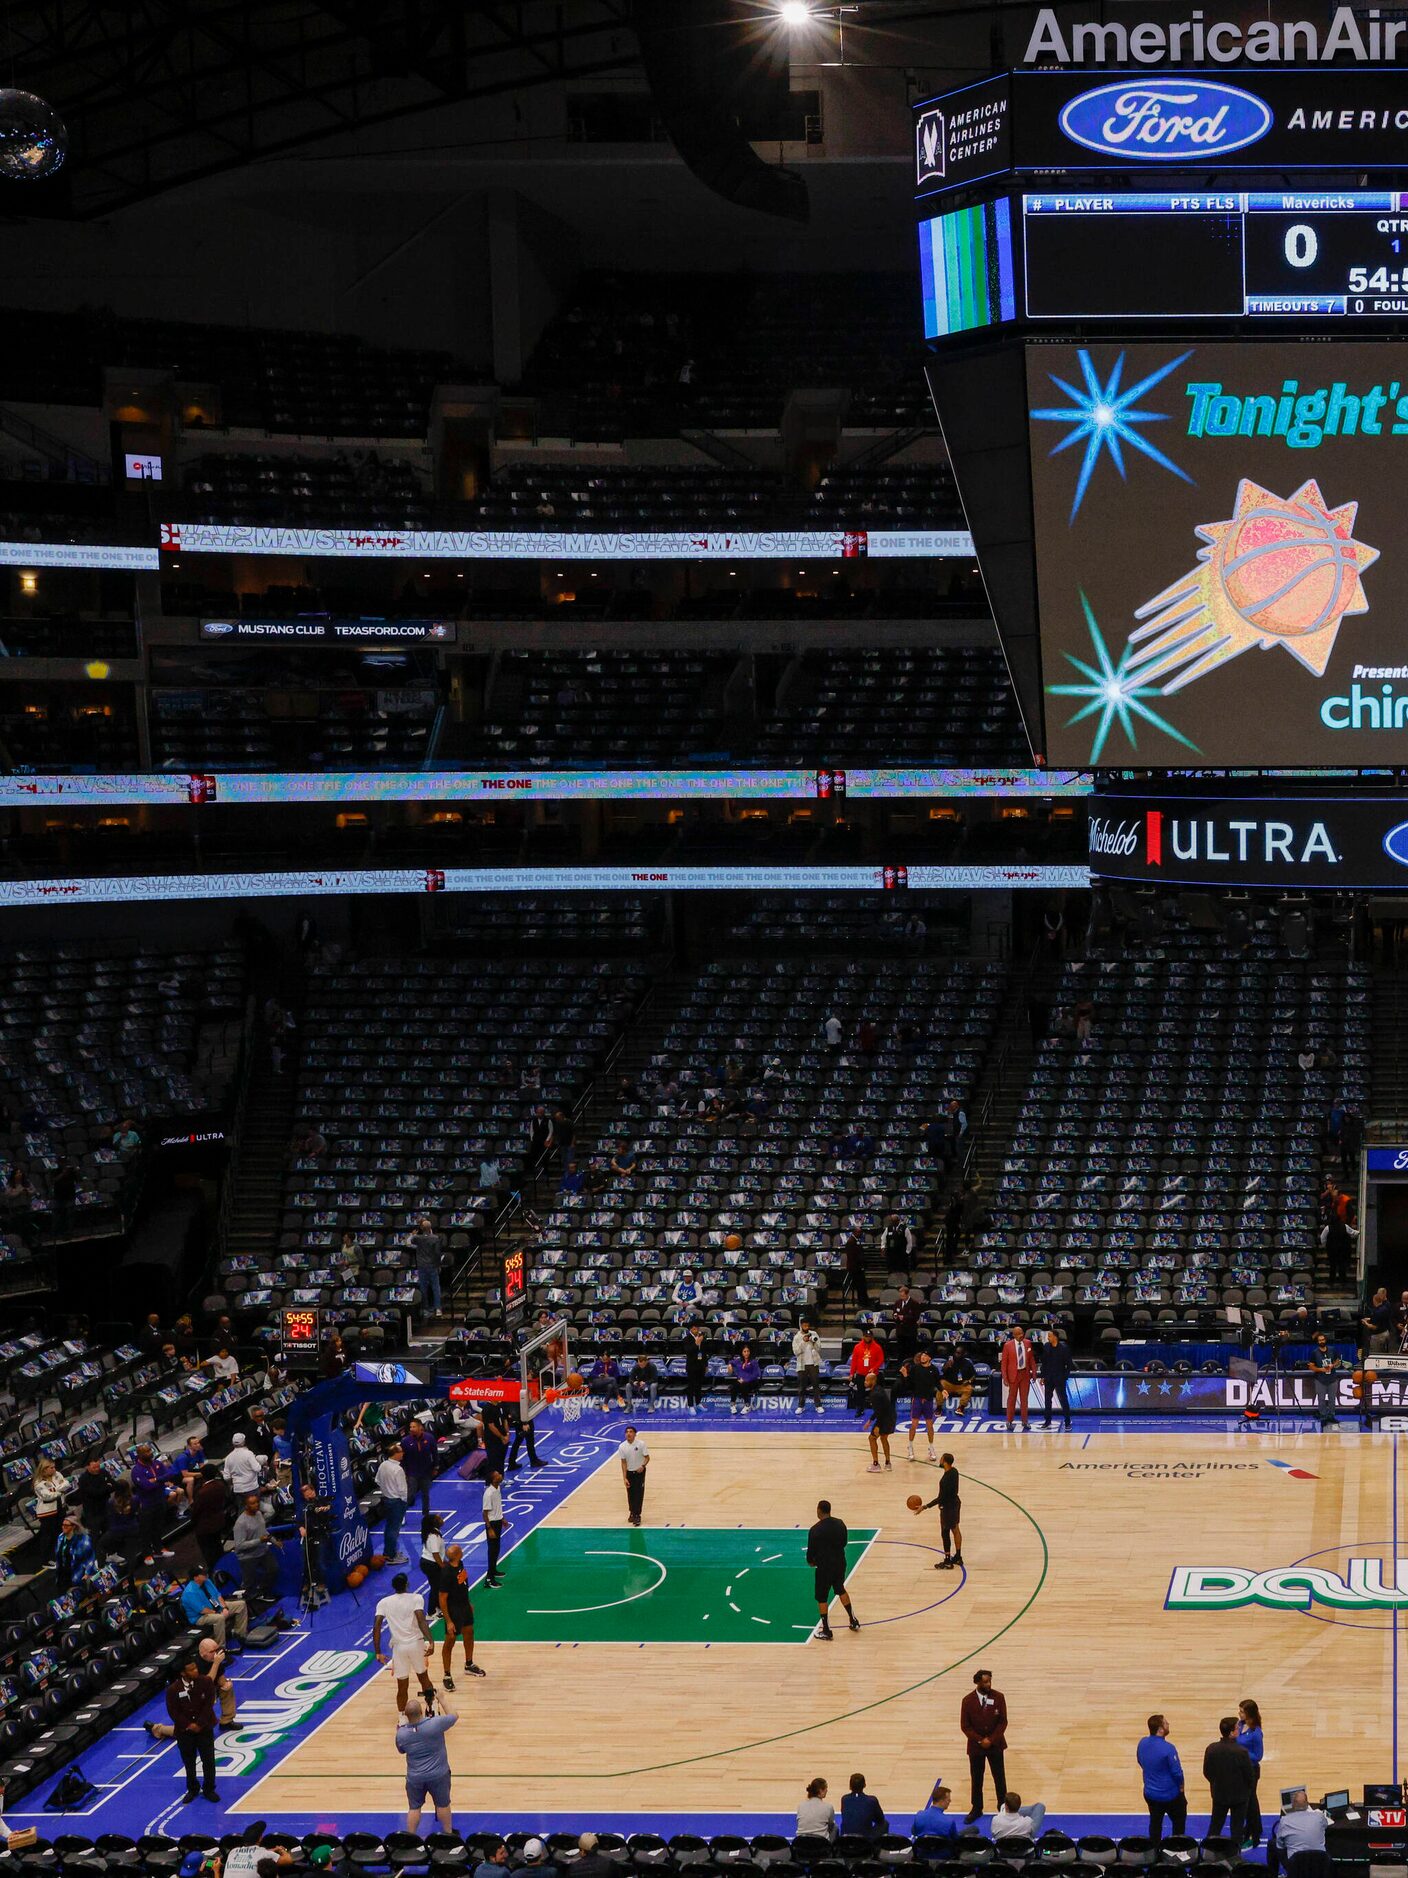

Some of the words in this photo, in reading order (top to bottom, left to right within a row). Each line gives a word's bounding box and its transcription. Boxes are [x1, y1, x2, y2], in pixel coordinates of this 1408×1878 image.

[949, 99, 1007, 130] AMERICAN
[1102, 91, 1230, 145] Ford
[949, 118, 1001, 146] AIRLINES
[1054, 199, 1114, 211] PLAYER
[1170, 198, 1201, 210] PTS
[1206, 198, 1235, 210] FLS
[1282, 195, 1355, 210] Mavericks
[1284, 223, 1318, 268] 0
[1391, 239, 1400, 253] 1
[1250, 301, 1319, 312] TIMEOUTS
[1326, 299, 1336, 314] 7
[1355, 299, 1364, 314] 0
[238, 624, 294, 635] MUSTANG
[296, 625, 325, 635] CLUB
[335, 626, 425, 636] TEXASFORD.COM
[481, 779, 505, 789] THE
[507, 779, 532, 789] ONE
[1172, 820, 1338, 863] ULTRA
[631, 873, 648, 881] THE
[649, 873, 668, 881] ONE
[195, 1132, 224, 1141] ULTRA
[505, 1269, 522, 1298] 24
[286, 1313, 314, 1325] 54:55
[292, 1324, 310, 1338] 24
[1058, 1461, 1171, 1471] American
[1176, 1461, 1259, 1471] Airlines
[1127, 1470, 1205, 1480] Center
[339, 1524, 369, 1561] Bally
[346, 1548, 363, 1567] SPORTS
[1384, 1811, 1402, 1824] TV
